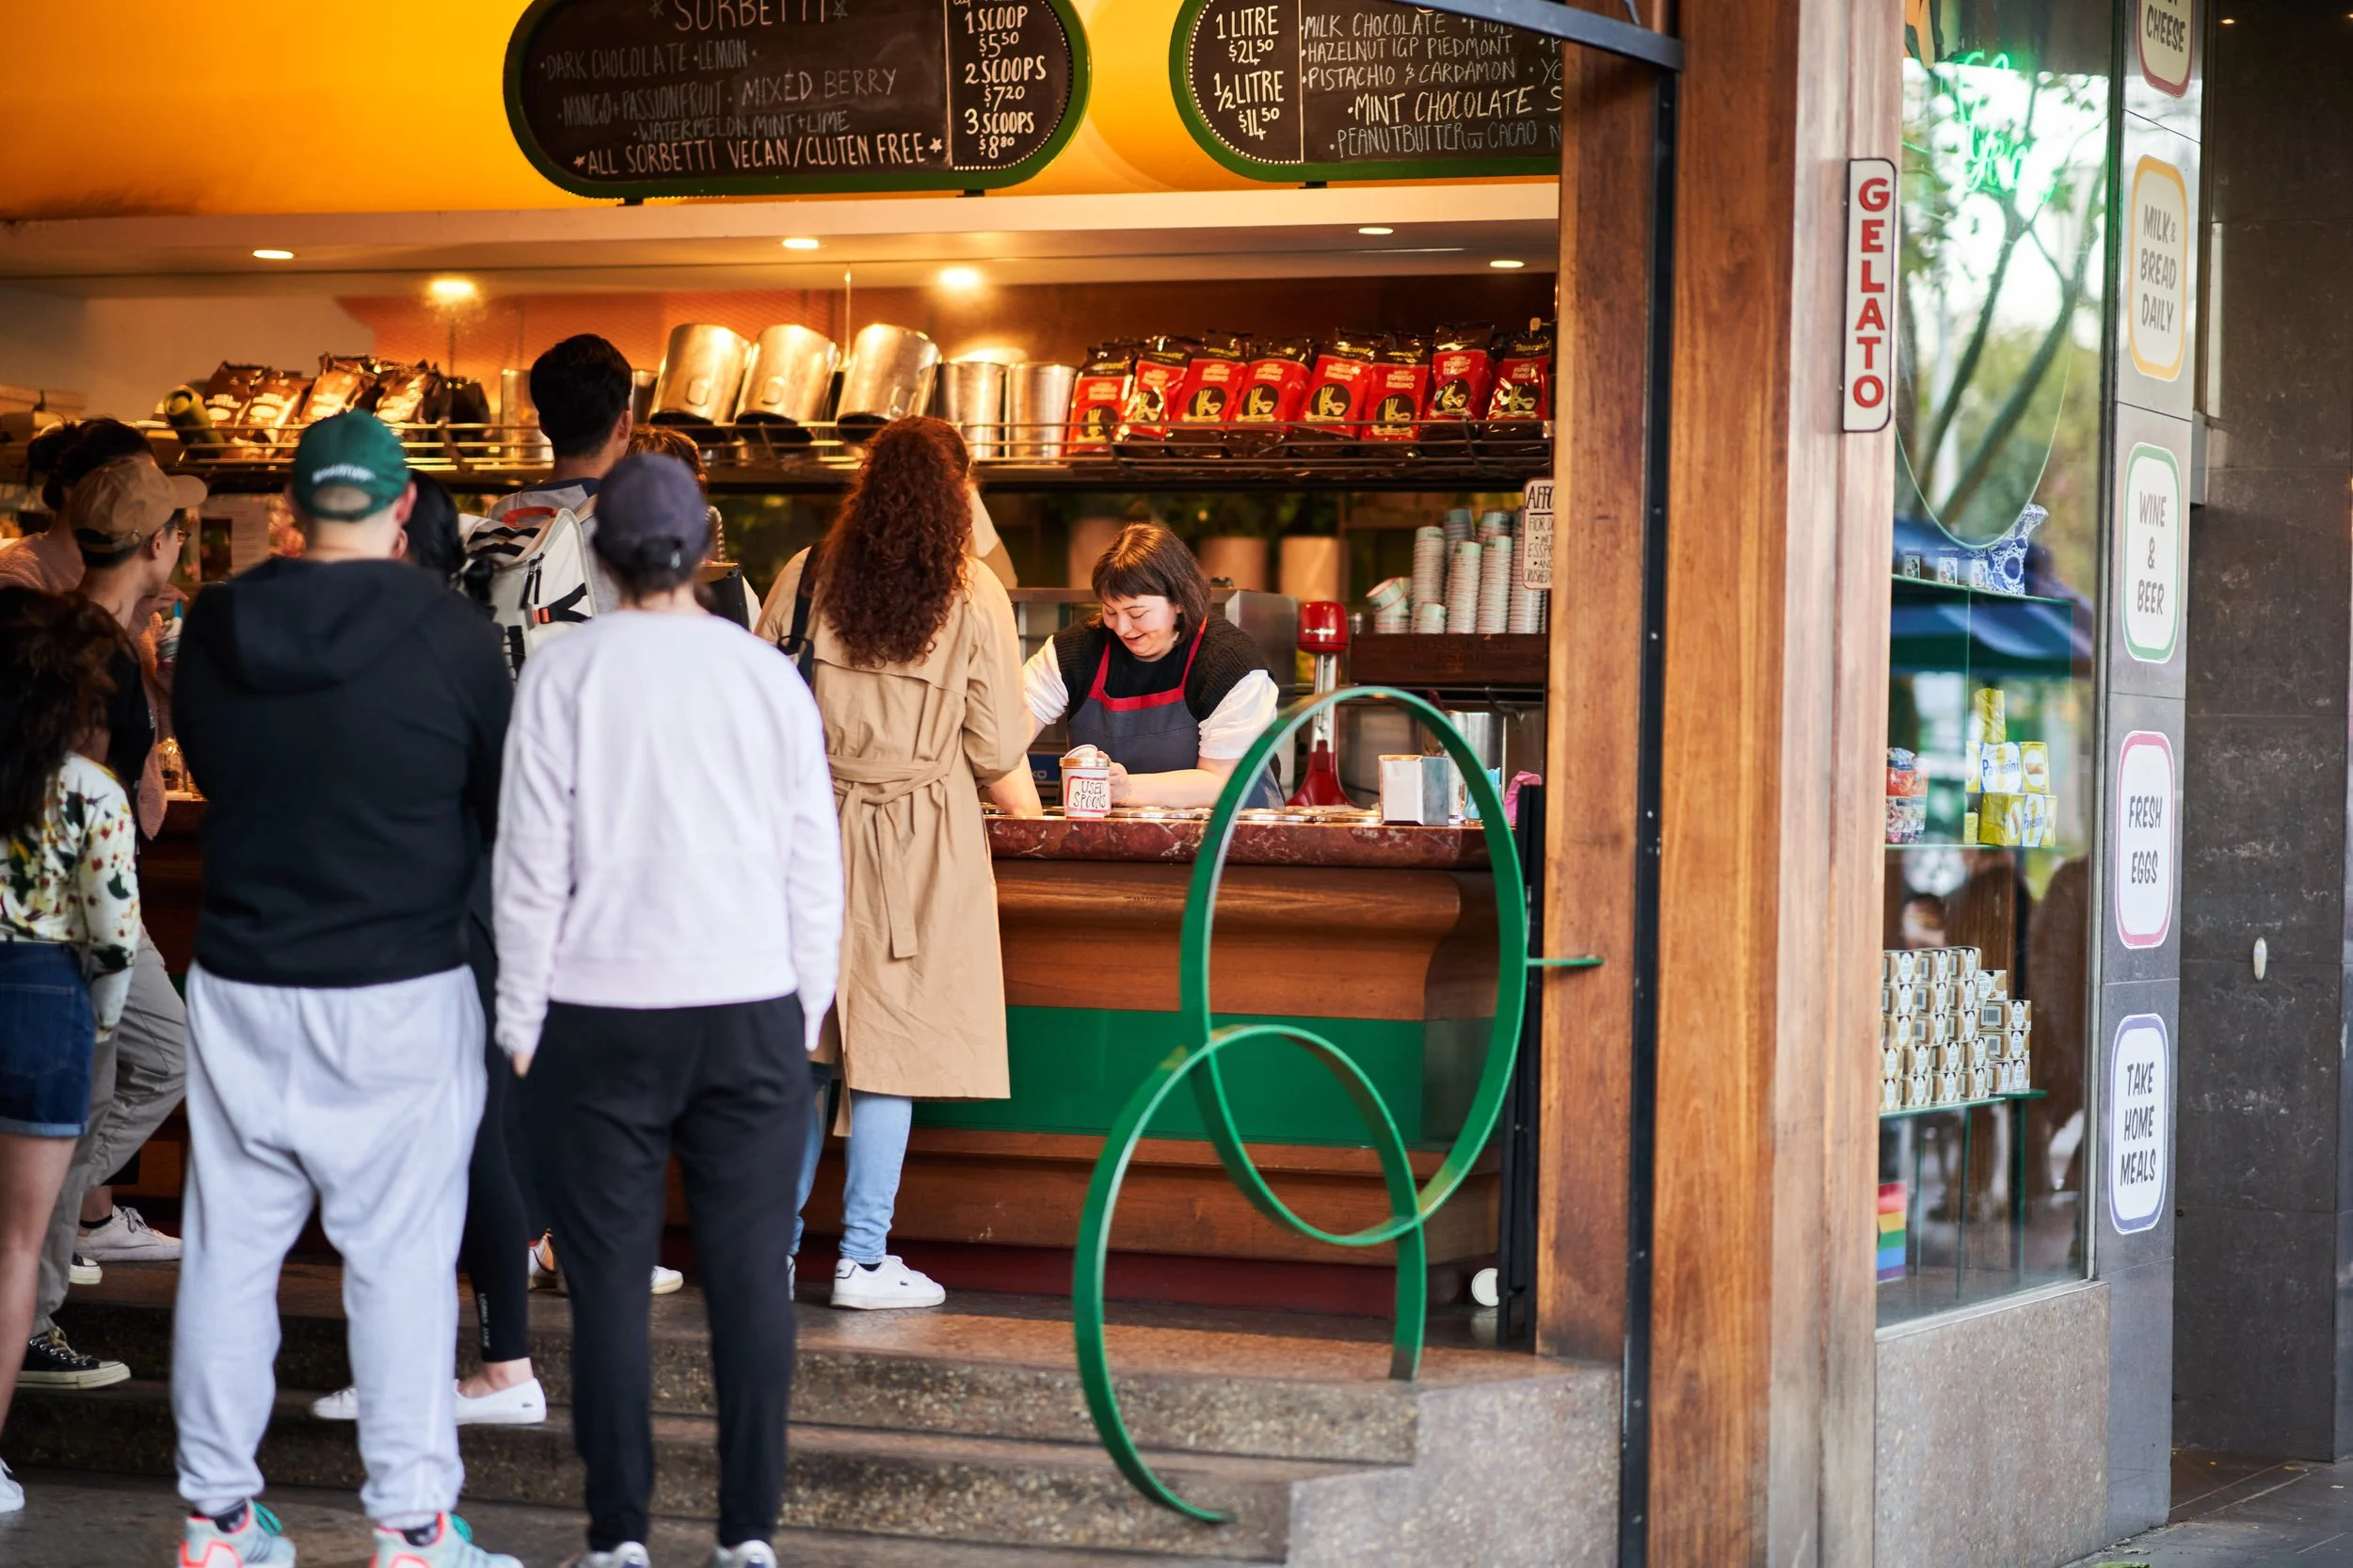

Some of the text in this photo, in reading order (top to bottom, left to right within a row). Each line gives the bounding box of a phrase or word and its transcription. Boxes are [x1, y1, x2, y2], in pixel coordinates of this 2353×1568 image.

[965, 6, 1029, 35] 1 SCOOP
[1215, 5, 1280, 39] 1 LITRE
[1304, 14, 1344, 40] MILK
[1353, 12, 1446, 38] CHOCOLATE
[2146, 4, 2185, 53] CHEESE
[546, 39, 748, 81] DARK CHOCOLATE LEMON
[1307, 35, 1513, 64] HAZELNUT IGP PIEDMONT
[741, 68, 897, 106] MIXED BERRY
[964, 55, 1047, 85] 2 SCOOPS
[1234, 70, 1285, 104] LITRE
[1307, 63, 1396, 91] PISTACHIO
[1418, 57, 1516, 84] CARDAMON
[964, 107, 1035, 135] 3 SCOOPS
[1354, 92, 1406, 126] MINT
[1415, 86, 1535, 123] CHOCOLATE
[1487, 120, 1538, 149] CACAO
[587, 149, 619, 176] ALL
[628, 139, 716, 174] SORBETTI
[877, 132, 926, 166] FREE
[2143, 202, 2176, 244] MILK &
[2140, 248, 2177, 290] BREAD
[1851, 177, 1891, 408] GELATO
[2141, 293, 2174, 334] DAILY
[1528, 517, 1545, 532] FIOR
[2139, 490, 2168, 528] WINE
[2147, 536, 2155, 570] &
[2137, 579, 2165, 615] BEER
[1073, 792, 1107, 809] SPOONS
[1080, 780, 1104, 795] USED
[2128, 795, 2163, 829] FRESH
[2131, 850, 2158, 885] EGGS
[2126, 1061, 2154, 1096] TAKE
[2124, 1105, 2154, 1142] HOME
[2120, 1148, 2156, 1187] MEALS
